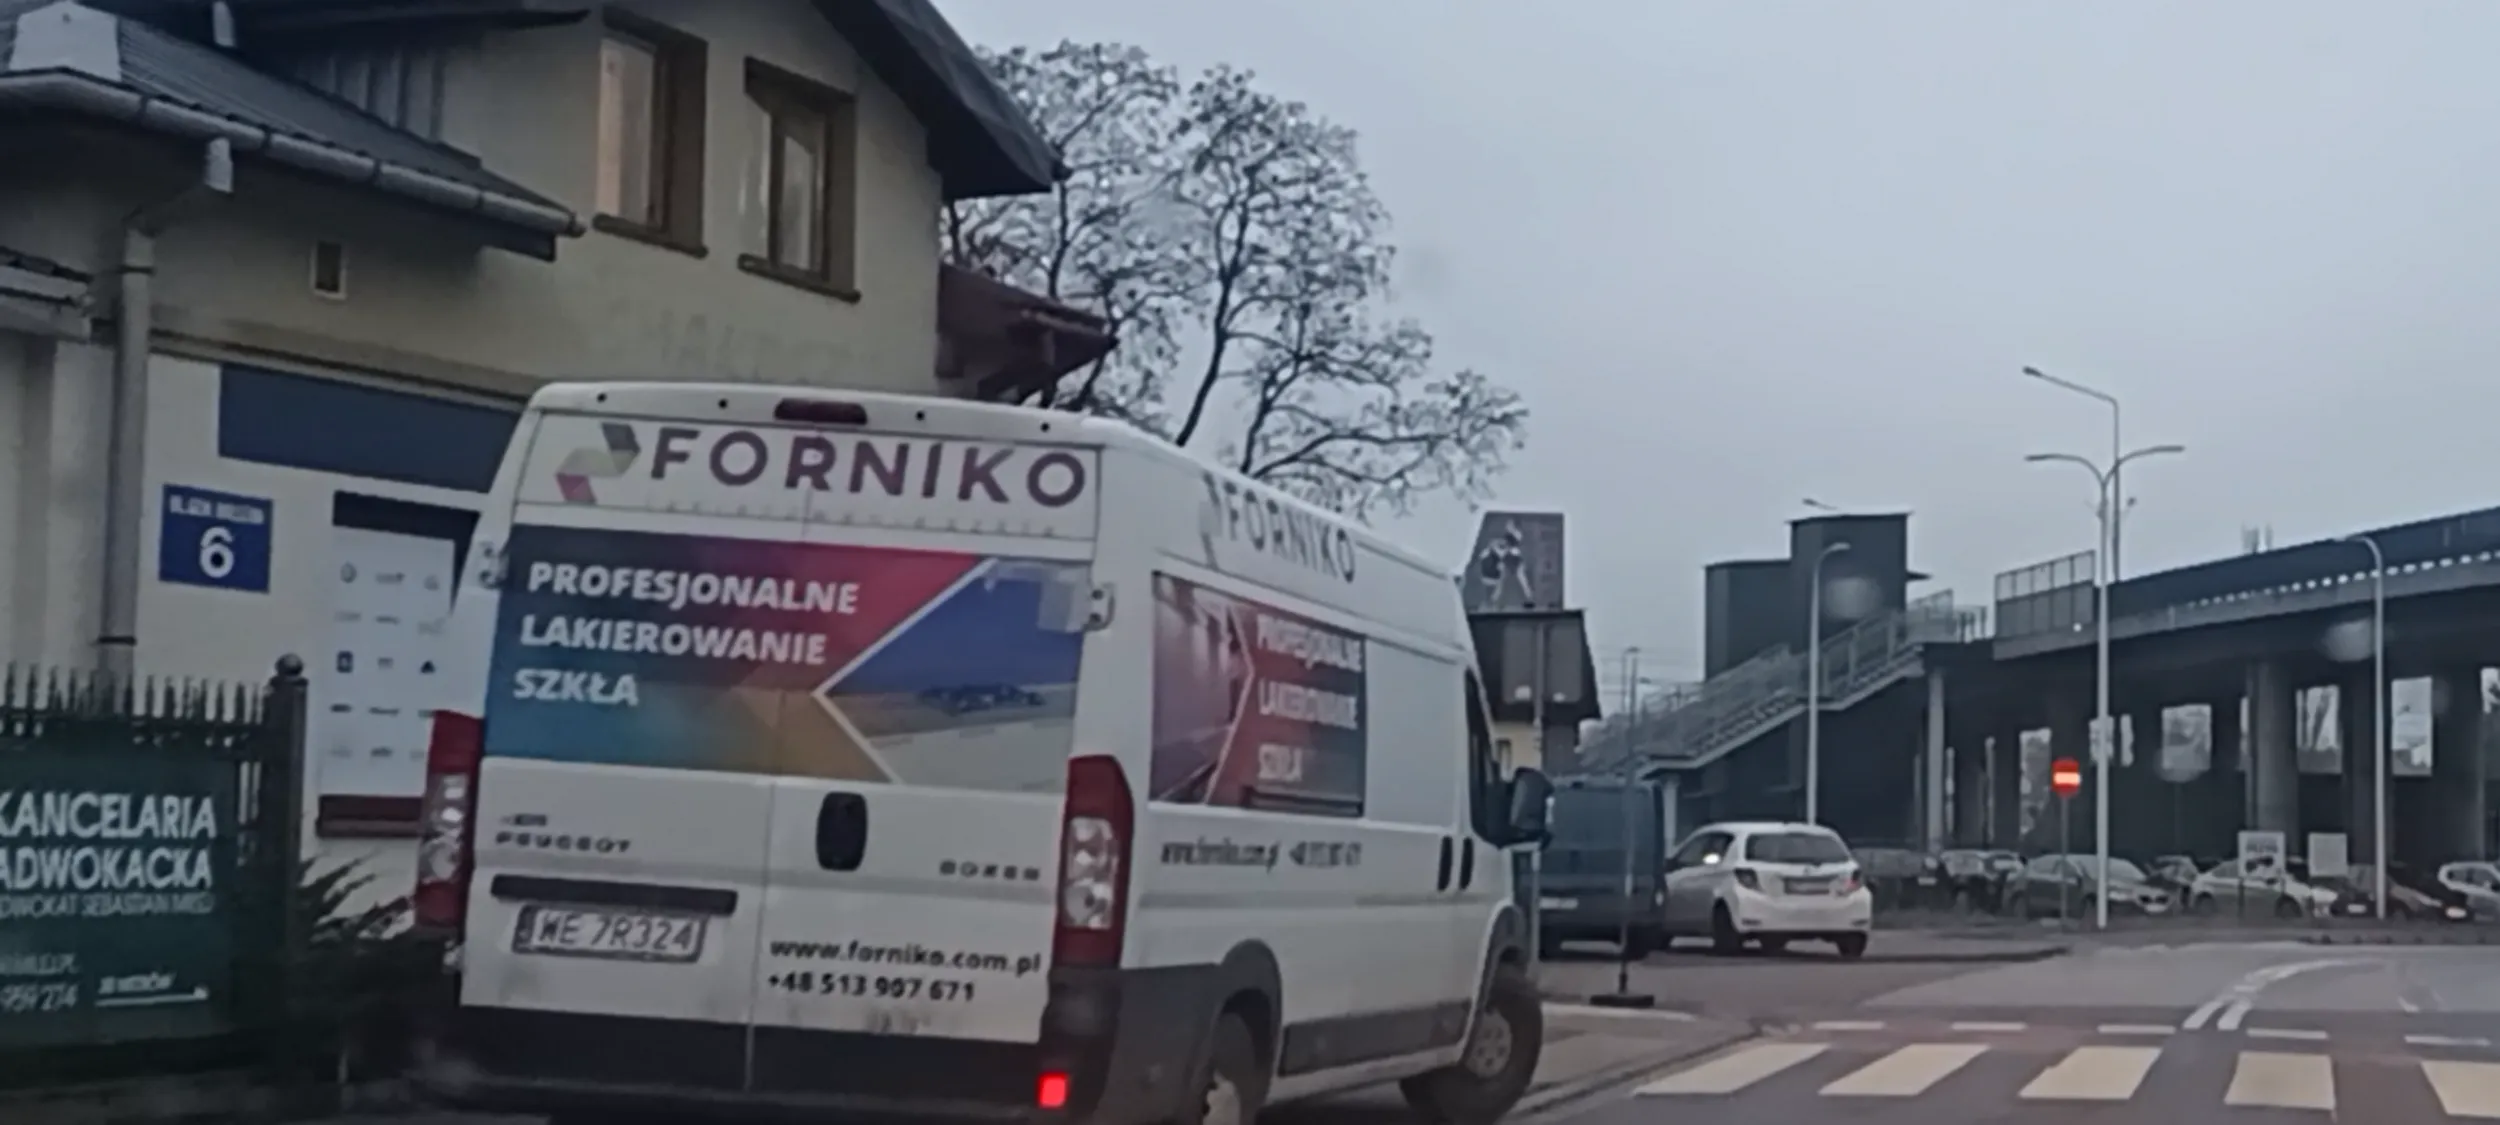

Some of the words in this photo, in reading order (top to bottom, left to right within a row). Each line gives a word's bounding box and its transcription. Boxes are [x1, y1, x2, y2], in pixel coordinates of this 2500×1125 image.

[650, 426, 1087, 508] FORNIKO
[201, 527, 235, 579] 6
[526, 561, 860, 616] PROFESJONALNE
[520, 614, 828, 665] LAKIEROWANIE
[513, 668, 638, 708] SZKŁA
[538, 911, 582, 946] WE
[589, 917, 697, 952] 7R324
[768, 938, 1042, 980] www.forniko.com.pl
[767, 971, 815, 995] +48
[820, 972, 868, 997] 513
[929, 979, 976, 1002] 671
